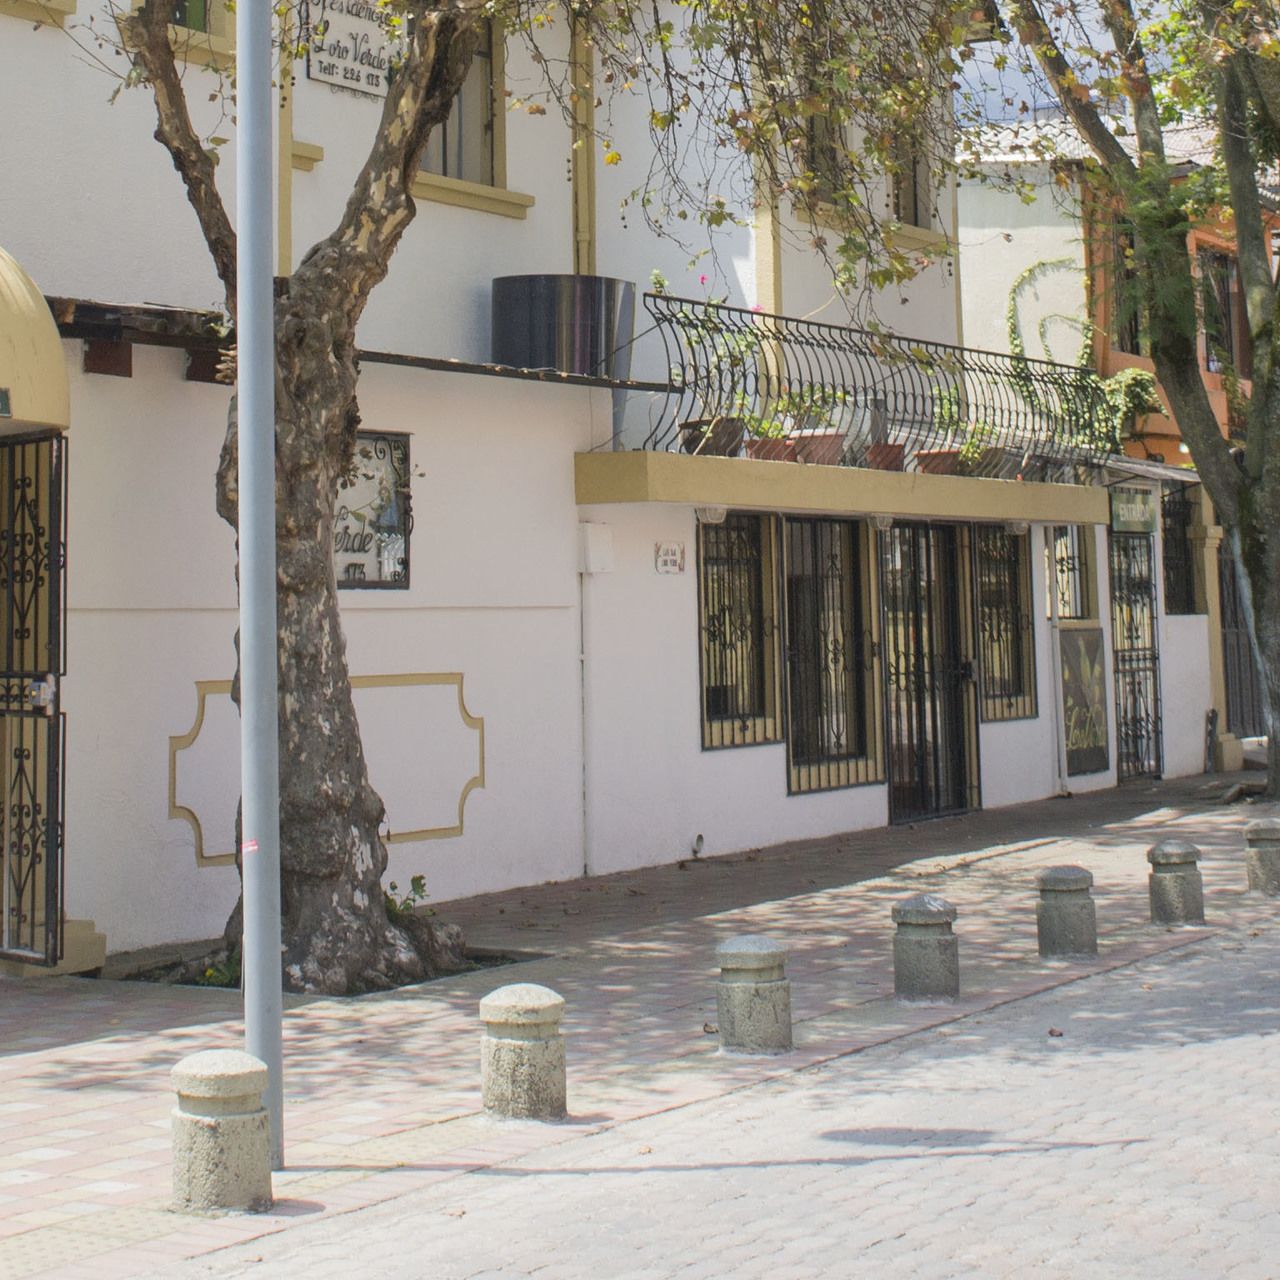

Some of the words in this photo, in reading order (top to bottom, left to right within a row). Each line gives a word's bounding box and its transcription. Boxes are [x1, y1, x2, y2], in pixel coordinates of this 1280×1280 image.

[313, 19, 349, 60] Loro
[349, 32, 386, 71] Verde
[317, 60, 339, 77] Telf:
[342, 66, 361, 83] 226
[366, 73, 380, 88] 173
[1119, 503, 1151, 522] ENTRADA
